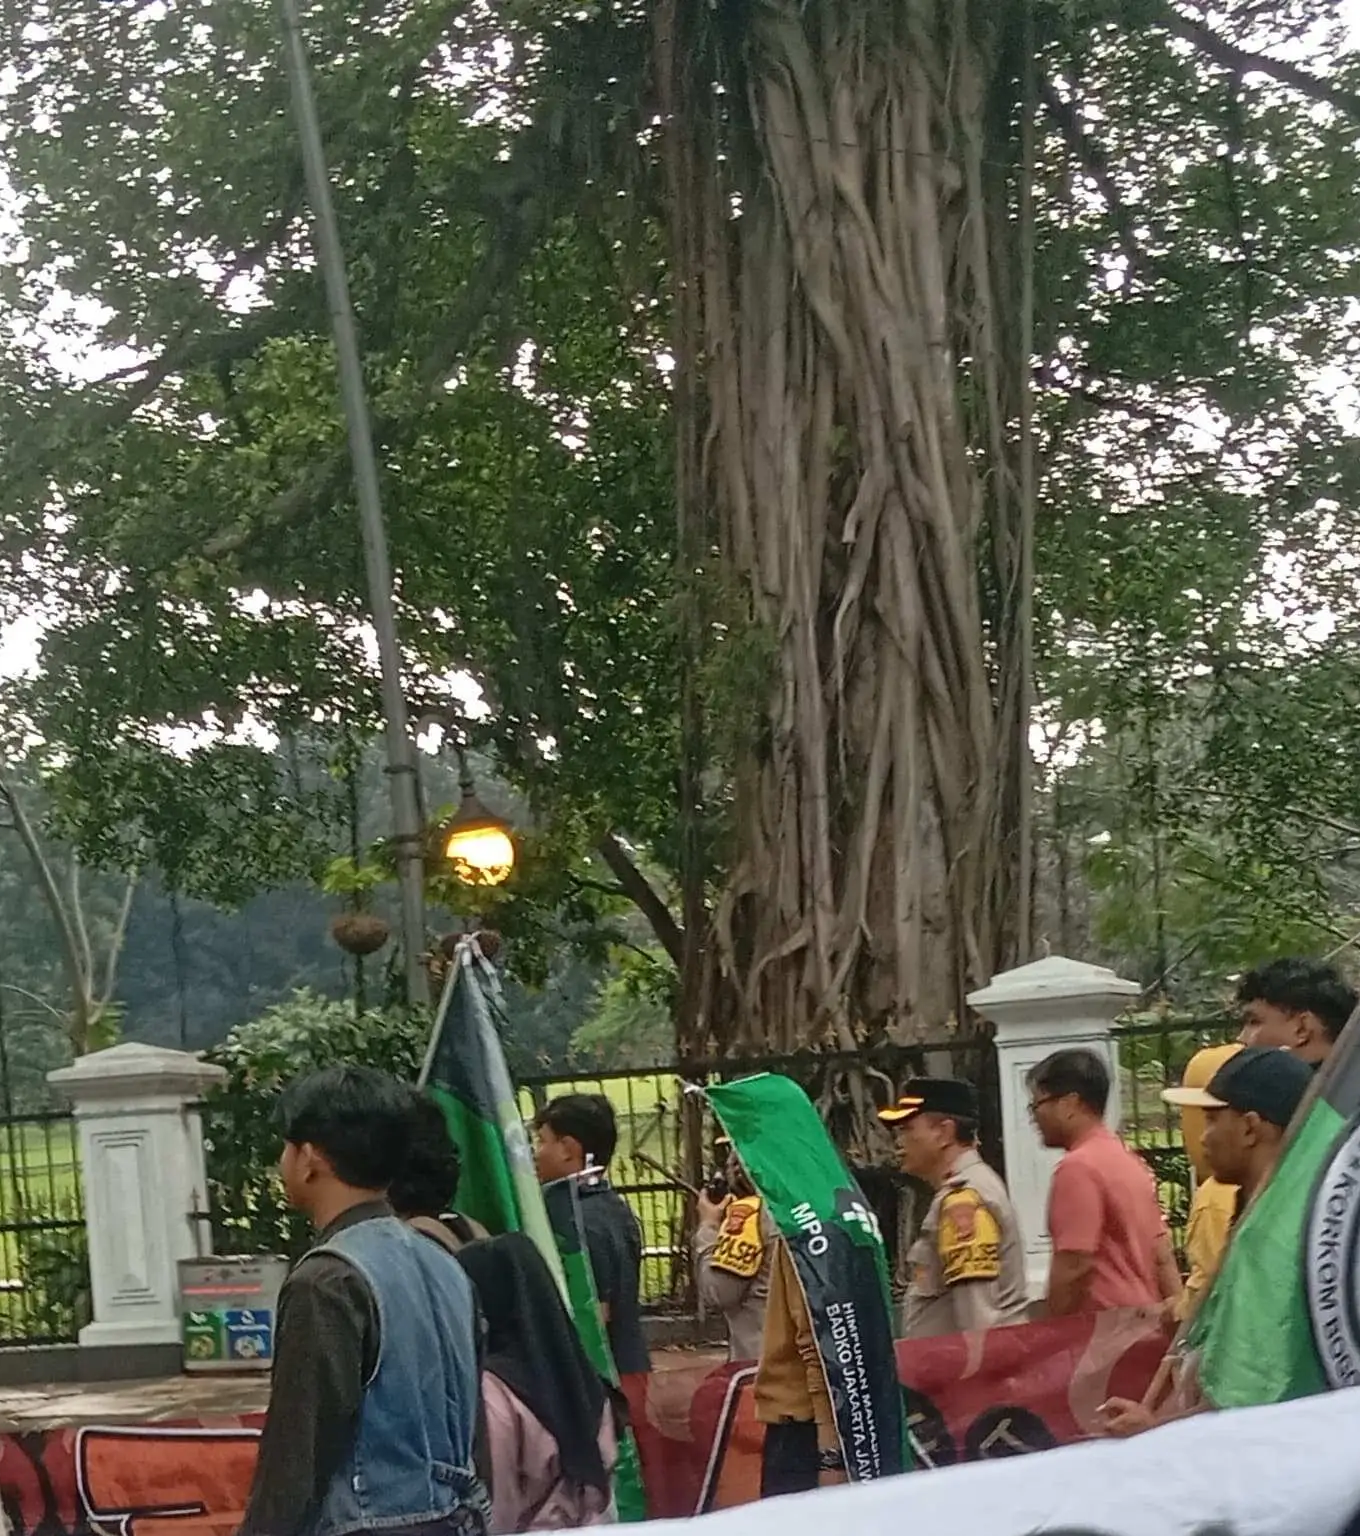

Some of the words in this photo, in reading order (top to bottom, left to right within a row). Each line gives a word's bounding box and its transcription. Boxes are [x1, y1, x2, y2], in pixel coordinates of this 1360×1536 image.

[790, 1201, 829, 1256] MPO
[826, 1302, 853, 1364] BADKO
[842, 1366, 867, 1447] JAKARTA
[841, 1301, 869, 1391] HIMPUNAN
